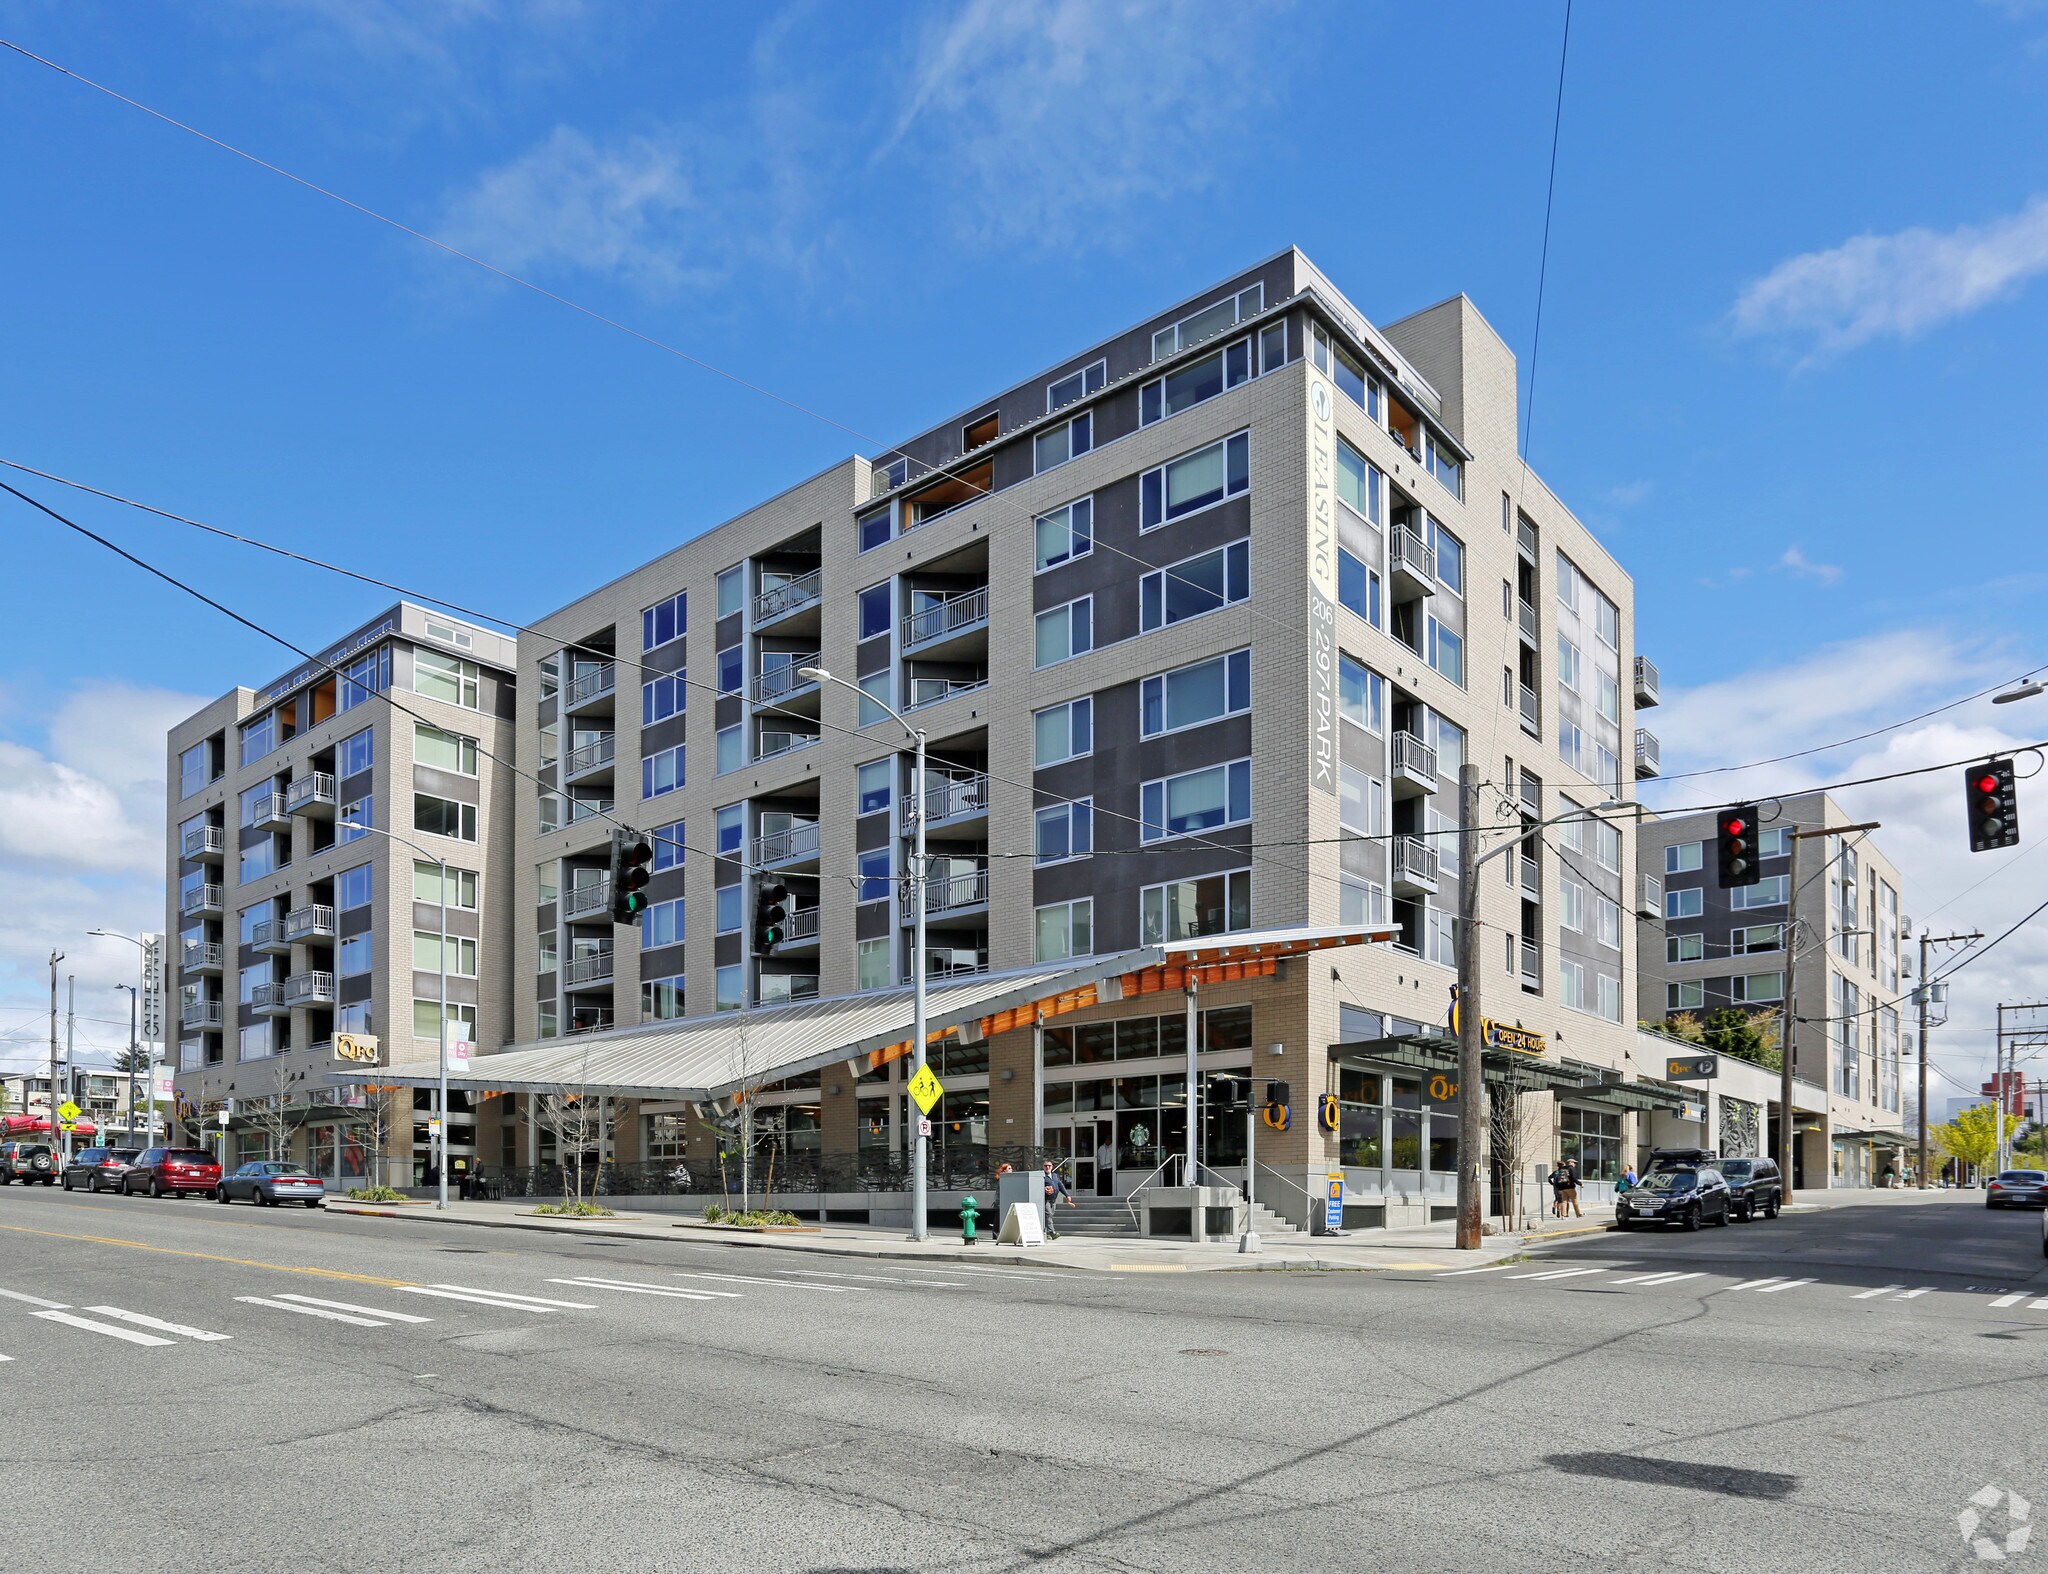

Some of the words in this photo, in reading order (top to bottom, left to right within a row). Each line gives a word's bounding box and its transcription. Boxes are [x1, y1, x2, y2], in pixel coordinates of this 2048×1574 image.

[1314, 421, 1330, 581] LEASING
[1313, 596, 1333, 625] 206
[338, 1039, 375, 1060] QFC
[1498, 1030, 1516, 1044] OPEN
[1517, 1033, 1527, 1048] 24
[1527, 1037, 1547, 1051] HOURS
[1669, 1064, 1688, 1075] QFC
[1430, 1079, 1459, 1101] QF
[1325, 1101, 1339, 1131] Q
